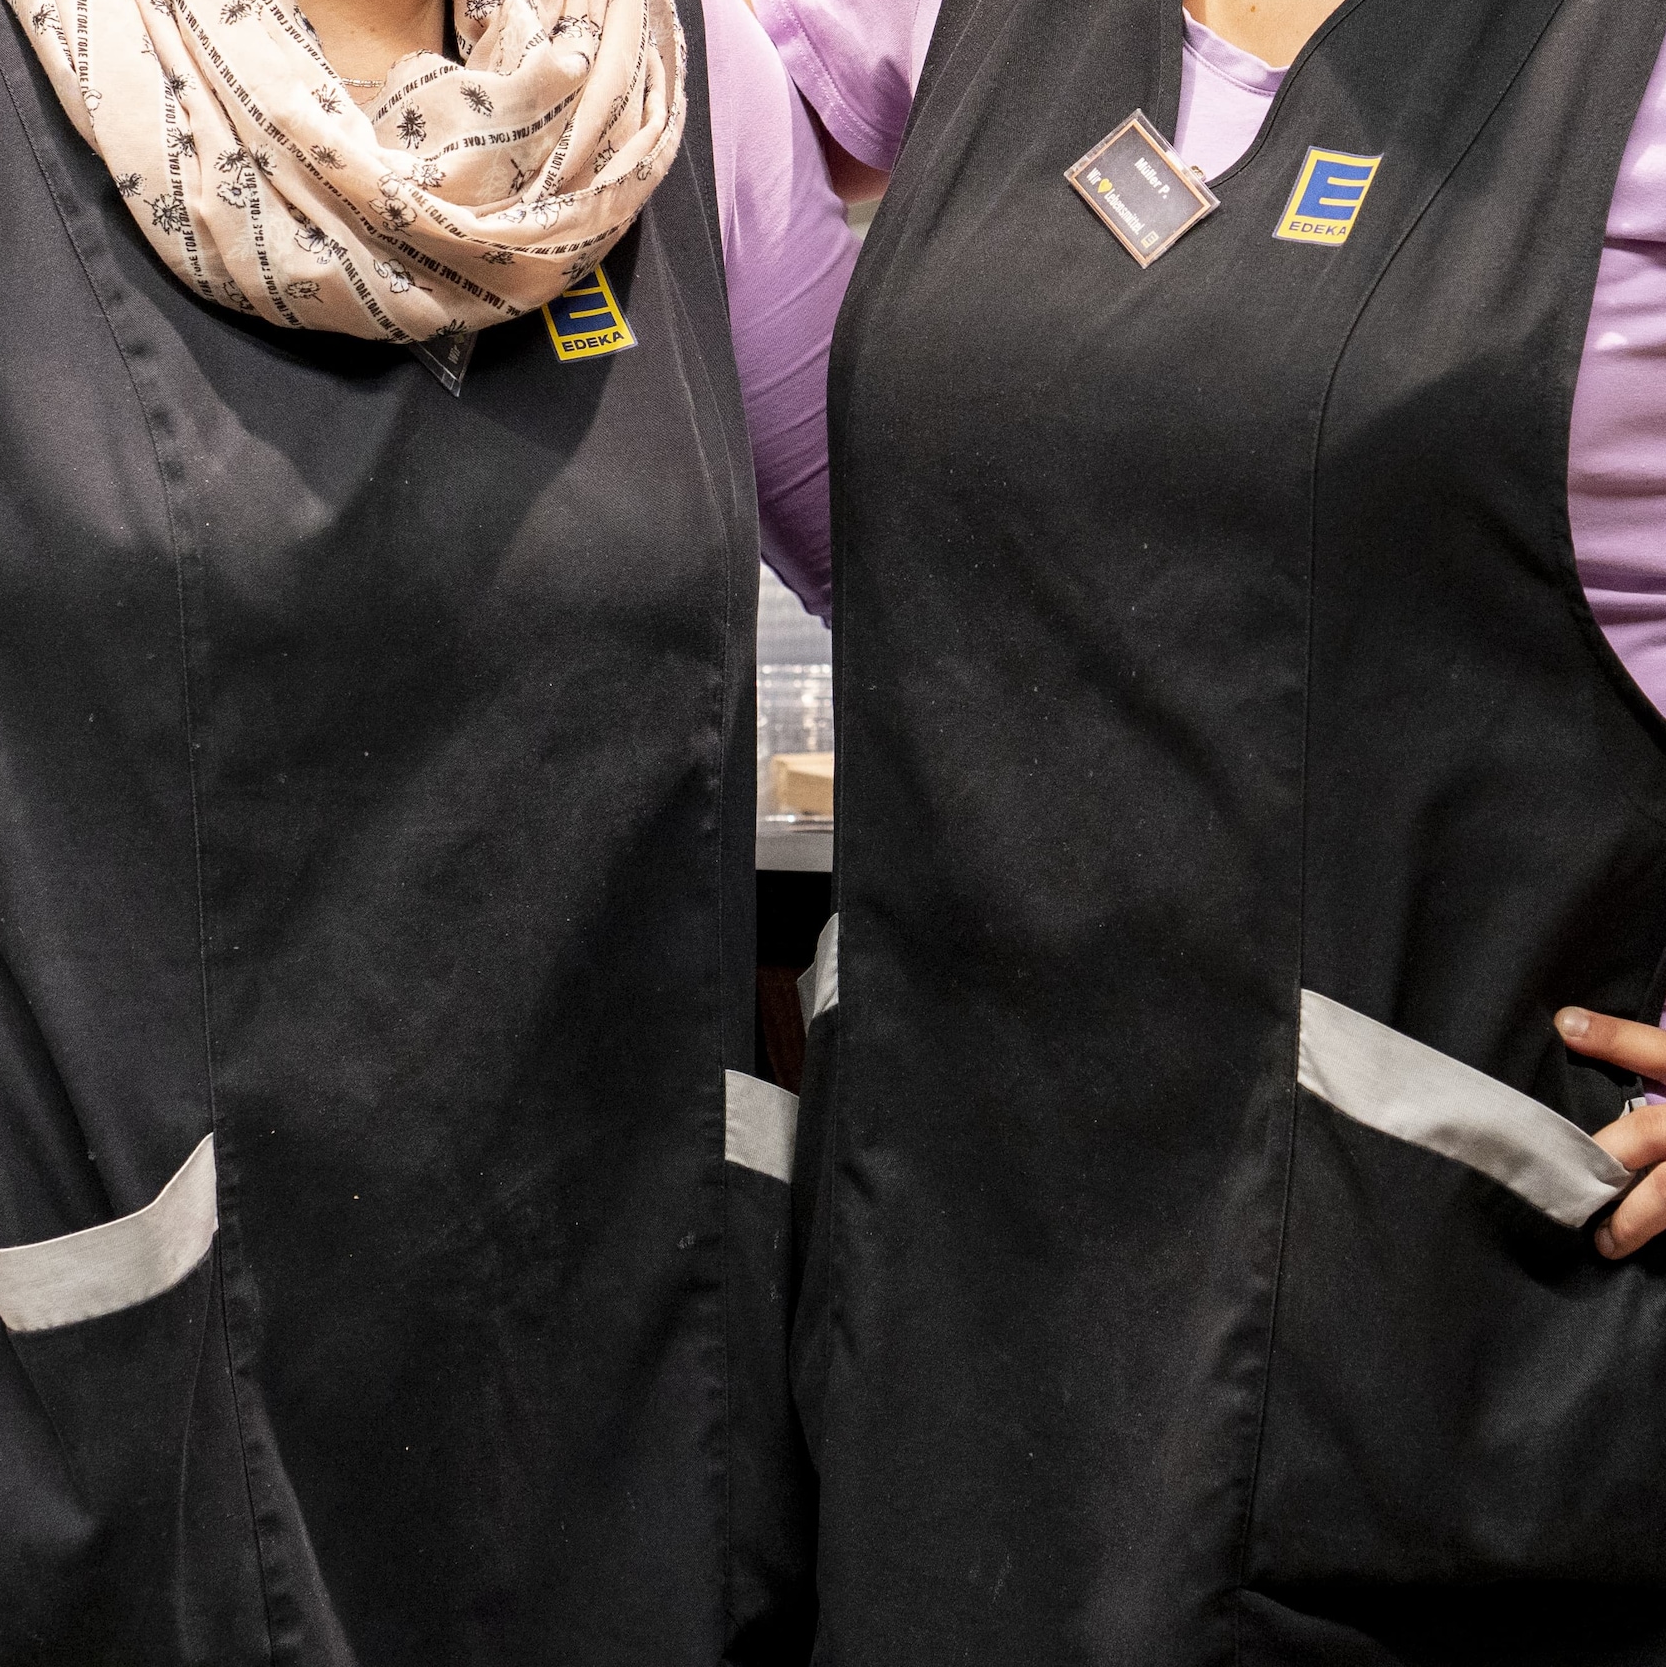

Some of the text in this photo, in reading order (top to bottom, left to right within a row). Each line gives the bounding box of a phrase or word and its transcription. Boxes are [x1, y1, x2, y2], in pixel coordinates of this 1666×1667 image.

[542, 134, 572, 191] LOVE LOVE LOVE
[1134, 157, 1170, 199] Müller P.
[1086, 167, 1145, 236] Wir Lebensmittel.
[1289, 221, 1347, 236] EDEKA
[562, 330, 624, 352] EDEKA
